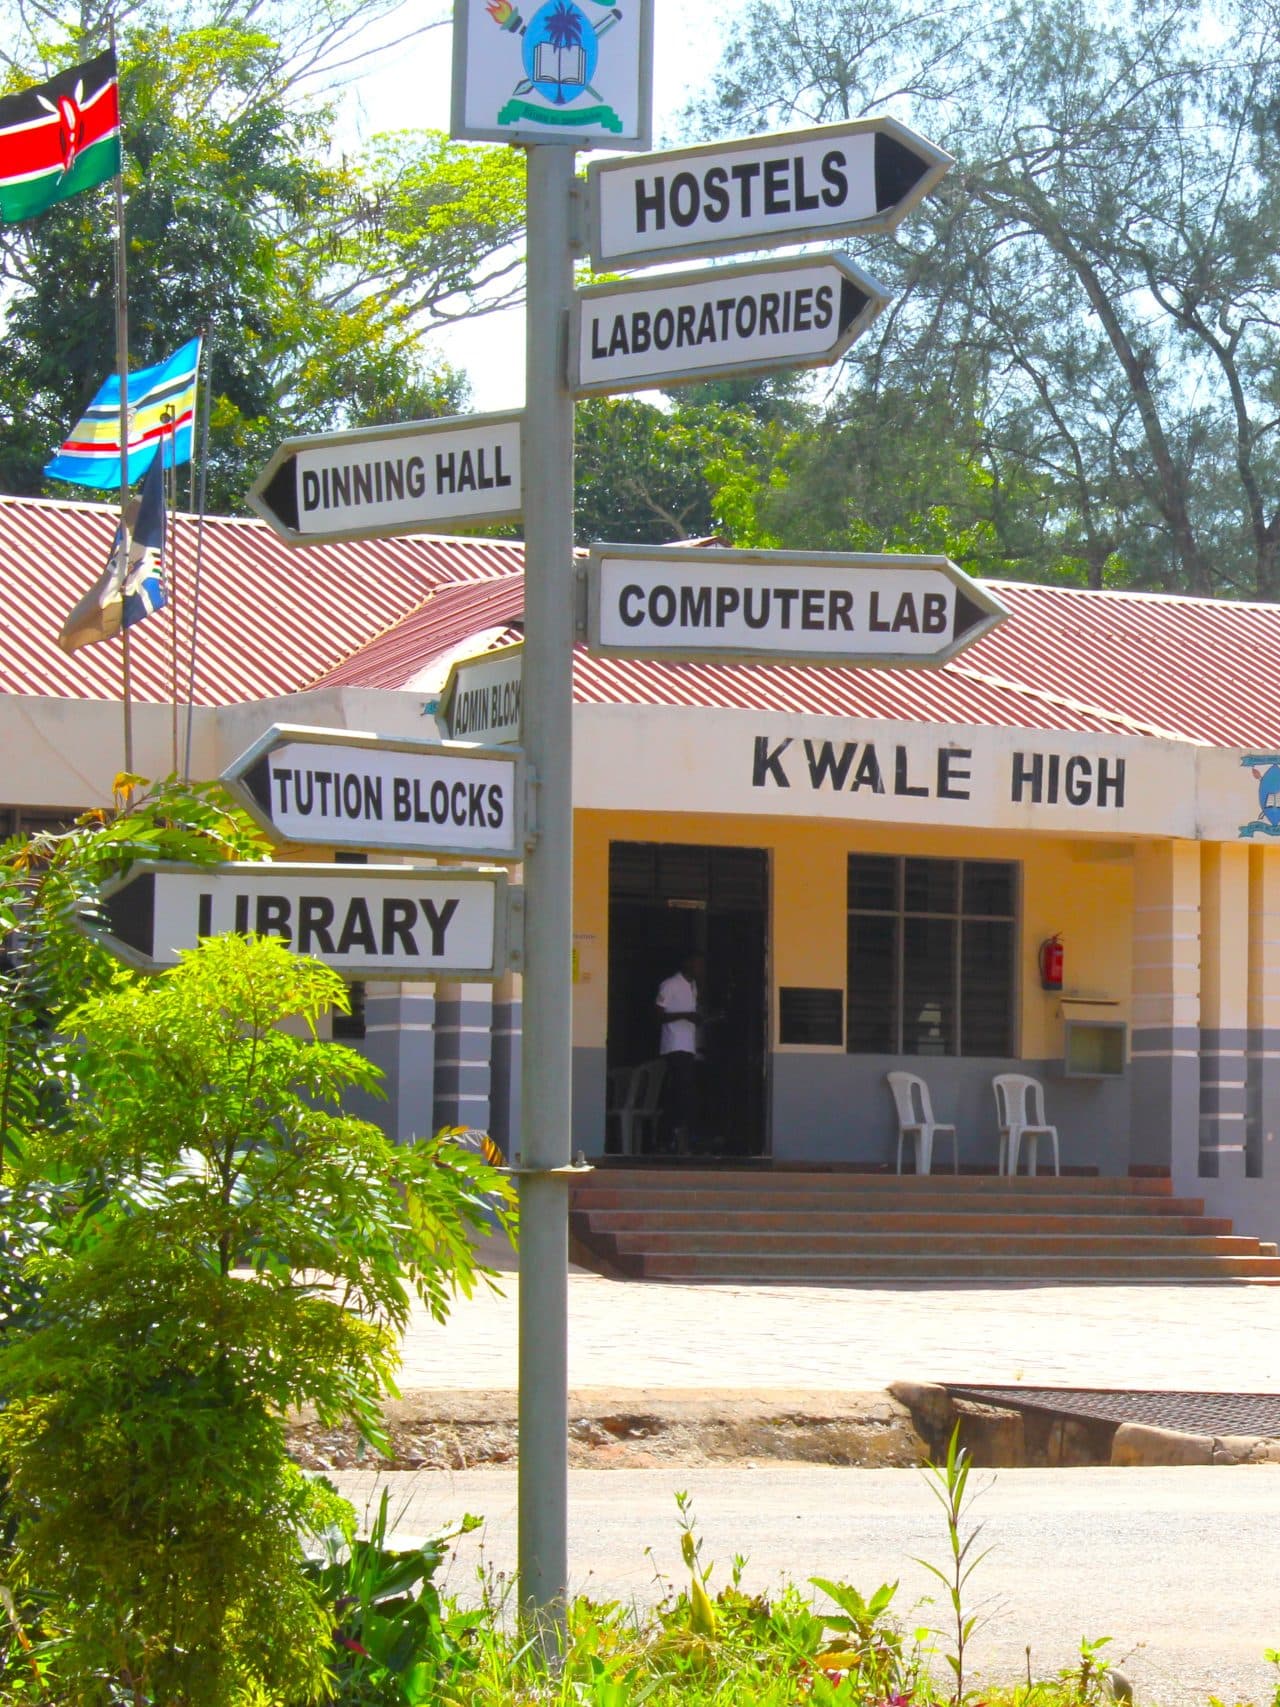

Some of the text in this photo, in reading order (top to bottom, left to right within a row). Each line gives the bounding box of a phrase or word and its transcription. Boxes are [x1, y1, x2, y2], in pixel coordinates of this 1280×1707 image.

[635, 150, 848, 233] HOSTELS
[591, 285, 833, 359] LABORATORIES
[302, 446, 511, 511] DINNING HALL
[618, 584, 948, 634] COMPUTER LAB
[455, 687, 489, 736] ADMIN
[273, 768, 503, 829] TUTION BLOCKS
[752, 736, 1125, 808] KWALE HIGH
